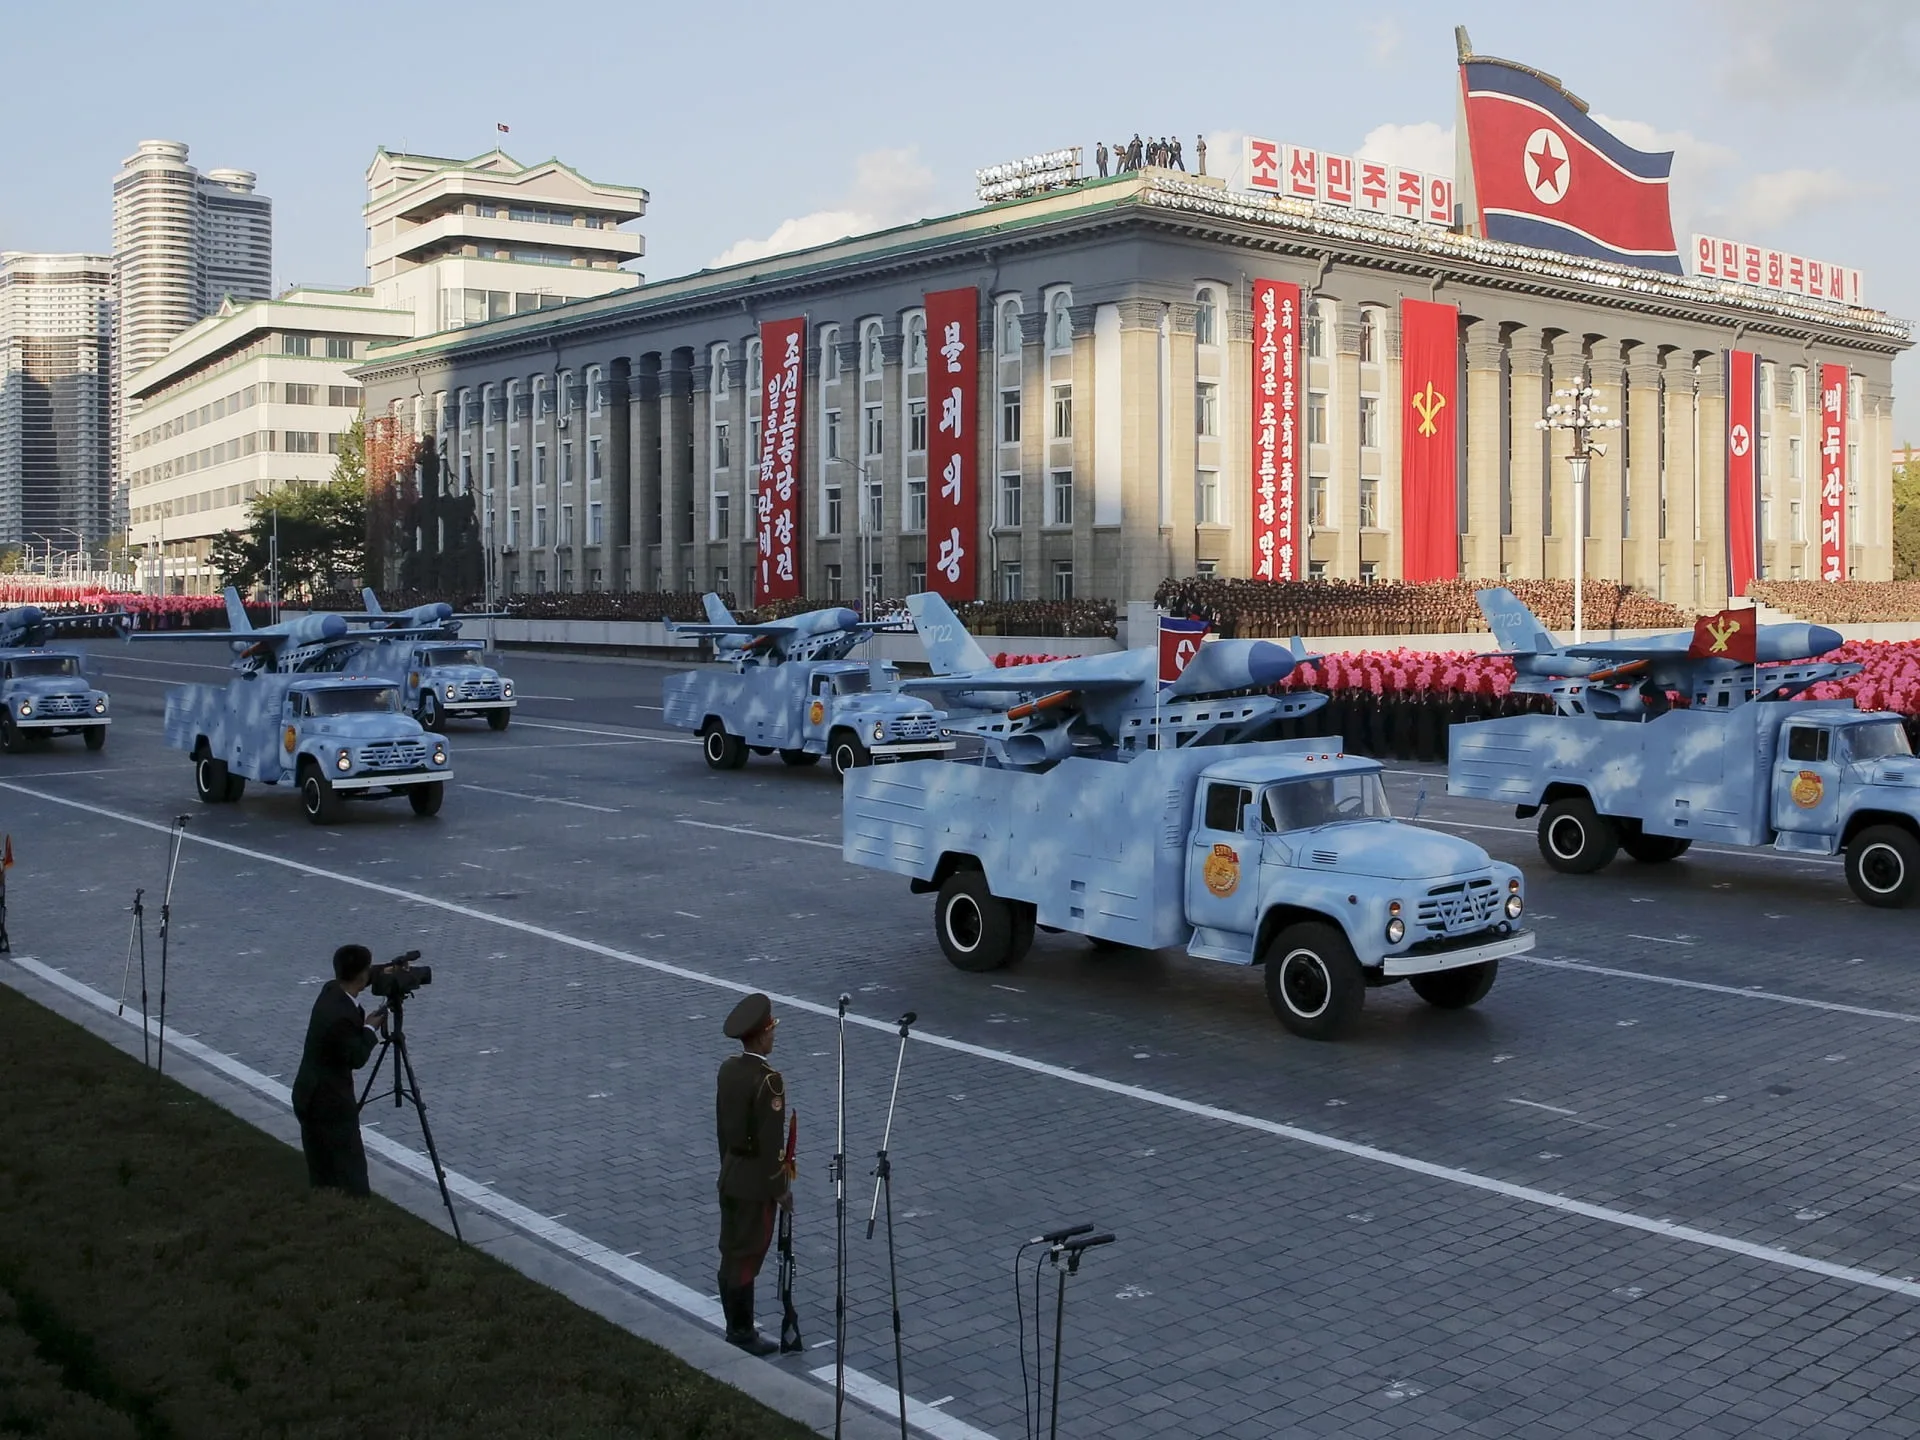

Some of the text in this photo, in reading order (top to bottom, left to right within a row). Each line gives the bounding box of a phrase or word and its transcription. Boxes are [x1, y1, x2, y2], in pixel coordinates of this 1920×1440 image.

[1252, 140, 1453, 222] 조선민주주의
[774, 332, 800, 581] 조선로동당 창건
[1257, 401, 1277, 525] 조선로동당
[929, 624, 953, 642] 722
[1499, 612, 1522, 628] 723
